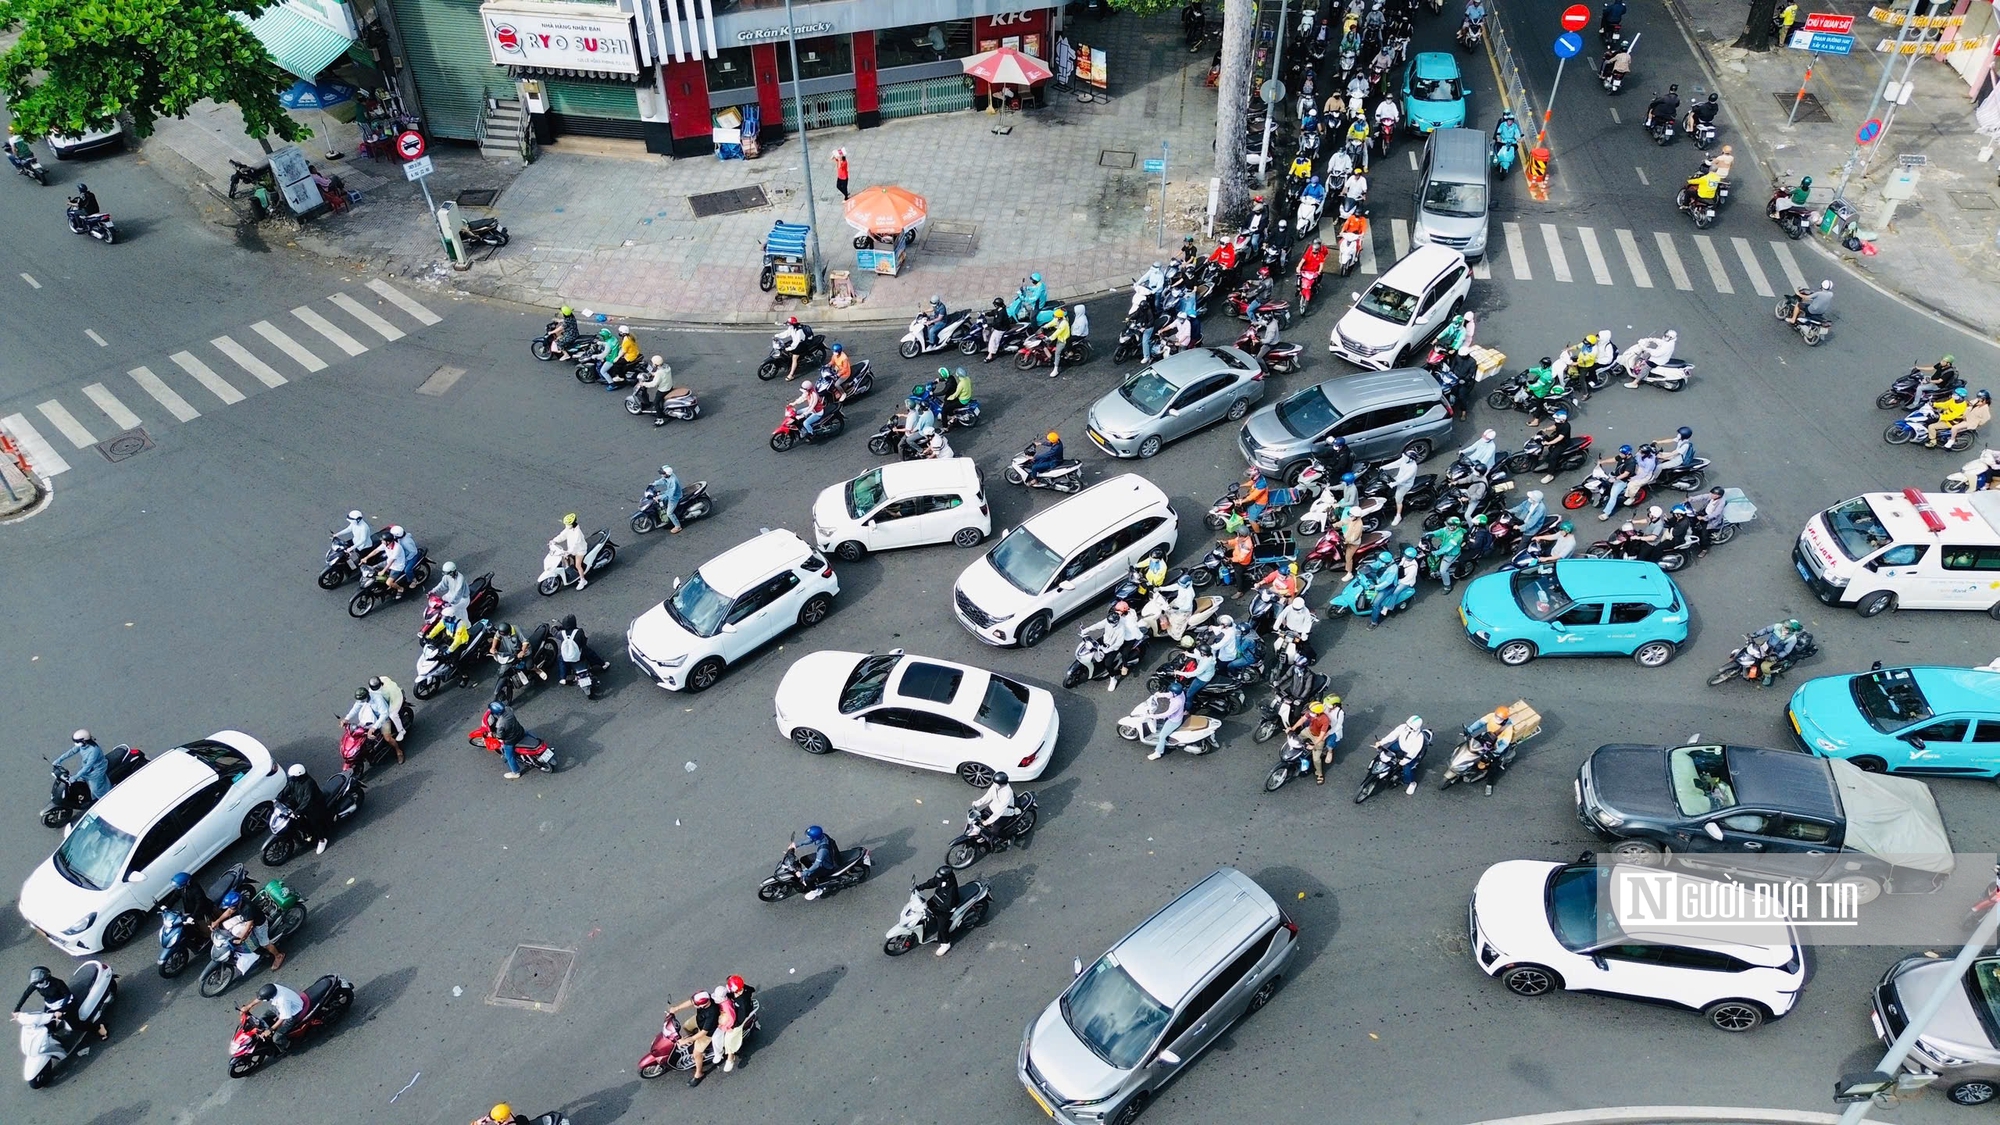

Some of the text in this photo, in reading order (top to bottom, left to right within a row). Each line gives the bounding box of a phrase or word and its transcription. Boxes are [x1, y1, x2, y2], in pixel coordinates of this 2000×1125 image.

[989, 10, 1033, 27] KFC
[737, 22, 833, 40] Gà Rán Kntucky
[574, 36, 630, 55] SUSHI
